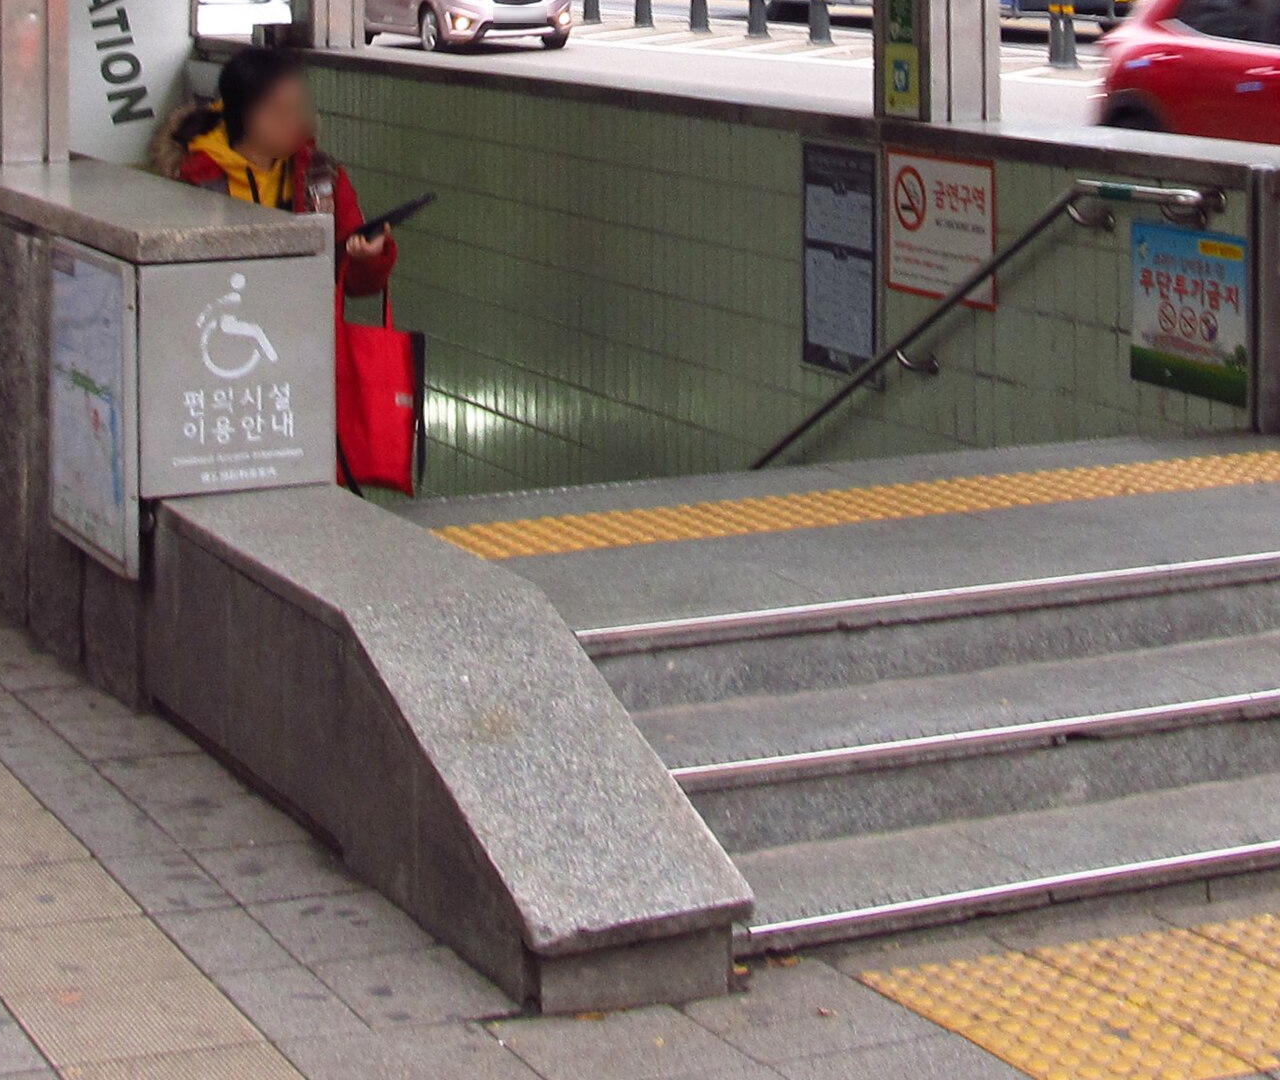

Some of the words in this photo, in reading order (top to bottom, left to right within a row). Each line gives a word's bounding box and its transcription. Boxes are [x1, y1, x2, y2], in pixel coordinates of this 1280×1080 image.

[1139, 267, 1240, 314] 무단투기금지
[183, 382, 291, 418] 편의시설
[183, 412, 295, 444] 이용안내
